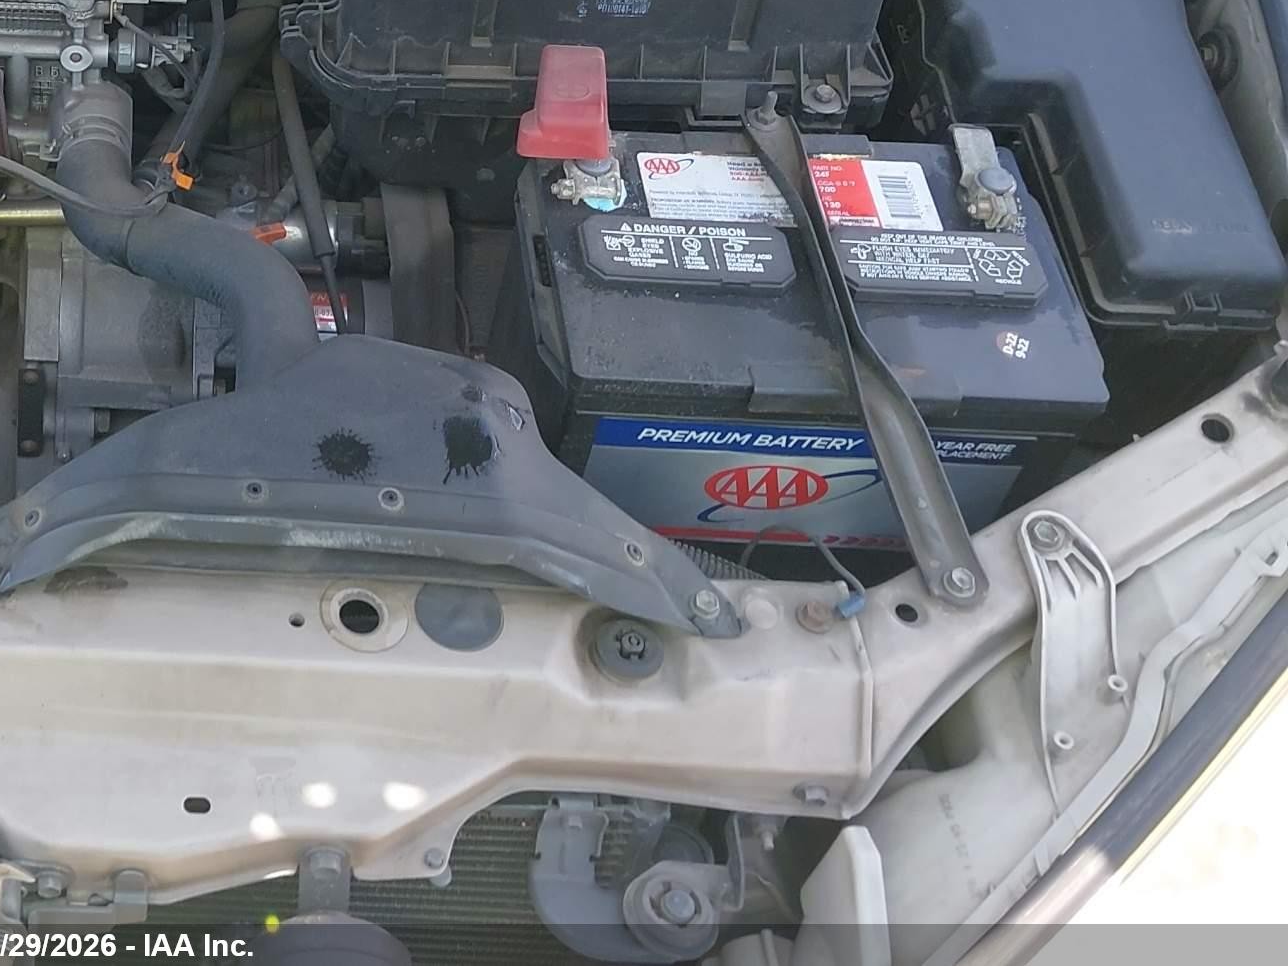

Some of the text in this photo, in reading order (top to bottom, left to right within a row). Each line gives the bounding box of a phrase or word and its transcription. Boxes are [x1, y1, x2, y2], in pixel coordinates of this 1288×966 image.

[647, 158, 679, 174] AAA
[633, 223, 686, 234] DANGER
[699, 226, 746, 237] POISON
[637, 428, 865, 452] PREMIUM BATTERY
[936, 440, 1016, 453] YEAR FREE
[935, 449, 1009, 460] PLACEMENT
[712, 466, 822, 509] AAA
